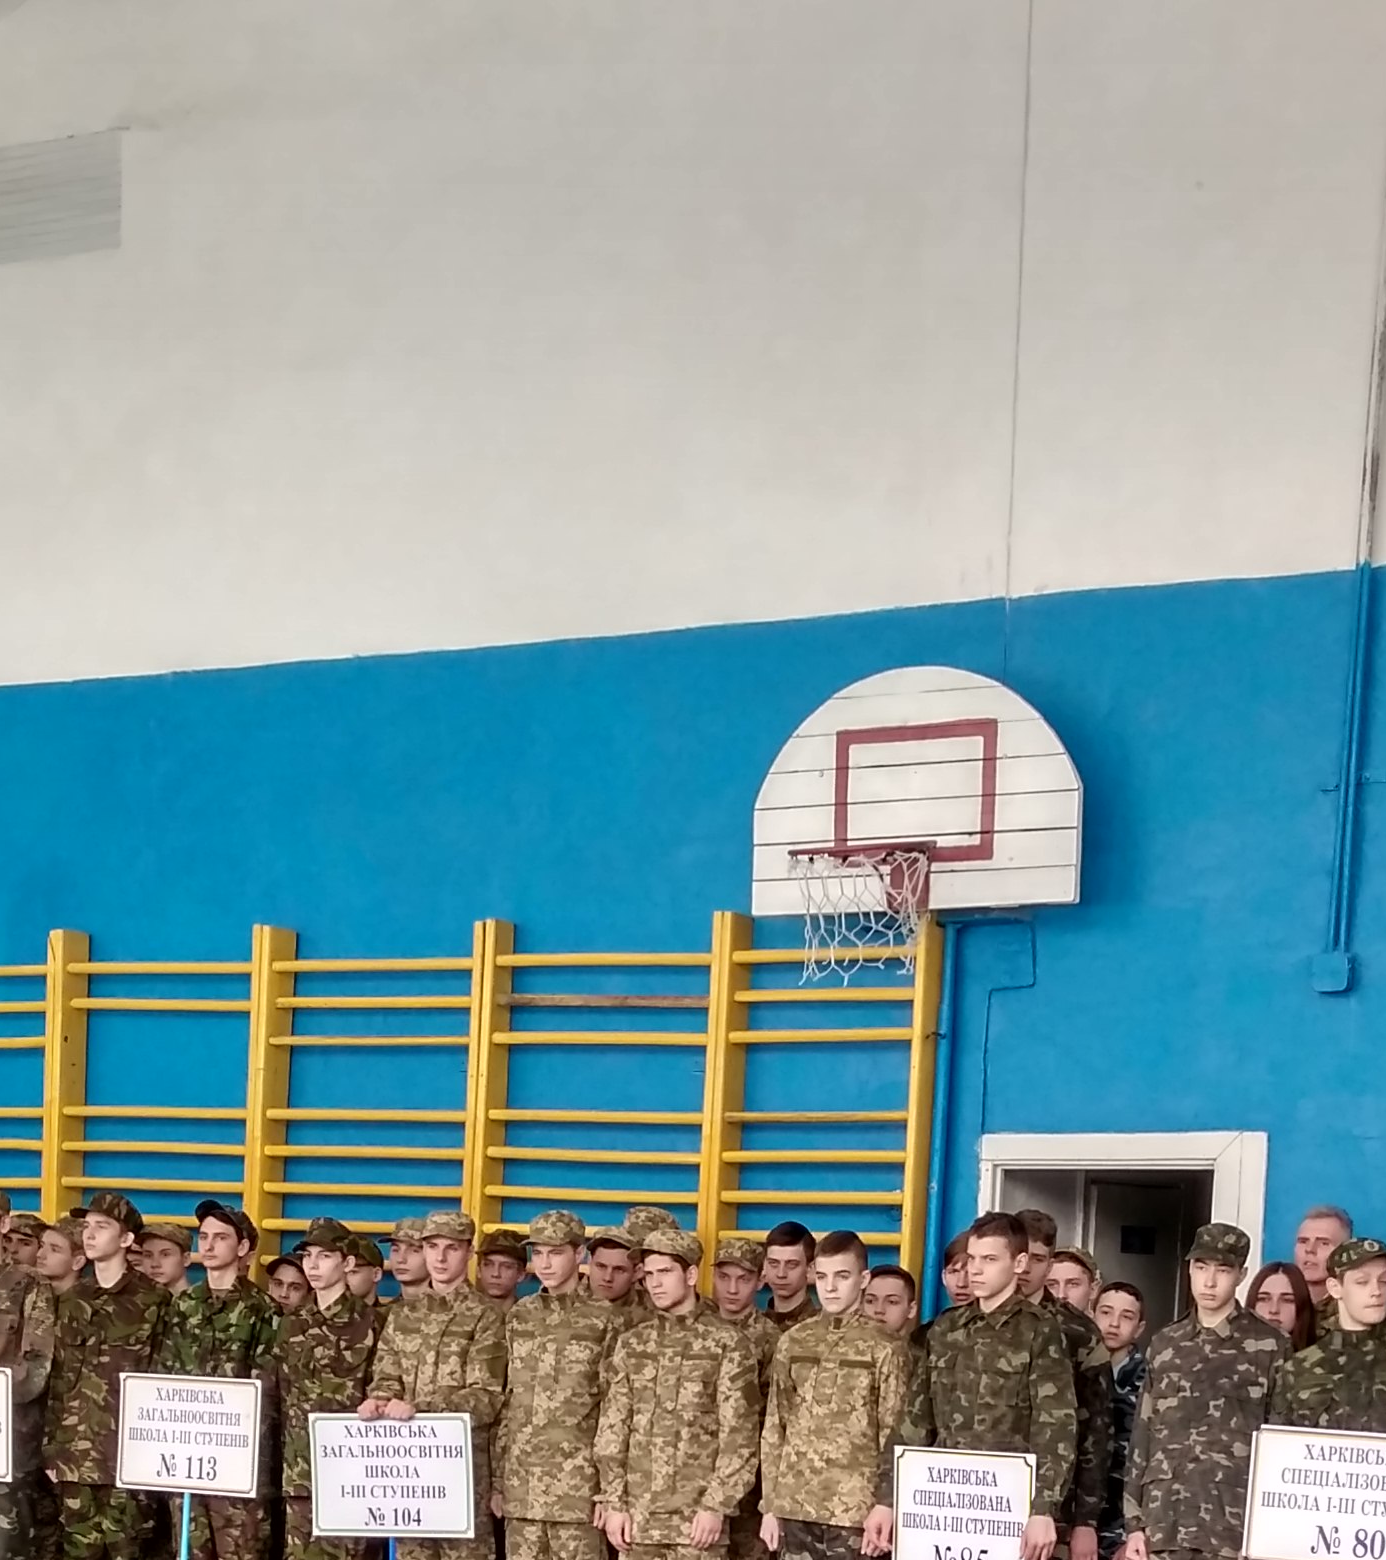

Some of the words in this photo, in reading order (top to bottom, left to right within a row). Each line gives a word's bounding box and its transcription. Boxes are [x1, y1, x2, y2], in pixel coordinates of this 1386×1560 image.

[156, 1387, 225, 1404] ХАРКІВСЬКА
[138, 1407, 241, 1426] ЗАГАЛЬНООСВІТНЯ
[128, 1427, 168, 1443] ШКОЛА
[194, 1431, 249, 1448] СТУПЕНІВ
[344, 1425, 438, 1438] ХАРКІВСЬКА
[320, 1445, 463, 1458] ЗАГАЛЬНООСВІТНЯ
[156, 1453, 177, 1477] №
[185, 1455, 218, 1481] 113
[365, 1465, 420, 1478] ШКОЛА
[927, 1467, 998, 1487] ХАРКІВСЬКА
[370, 1485, 447, 1499] СТУПЕНІВ
[913, 1489, 1012, 1513] СПЕЦІАЛІЗОВАНА
[1261, 1491, 1321, 1511] ШКОЛА
[364, 1507, 386, 1526] №
[392, 1507, 422, 1526] 104
[902, 1512, 941, 1531] ШКОЛА
[965, 1517, 1024, 1538] СТУПЕНІВ
[1310, 1525, 1341, 1555] №
[1352, 1528, 1386, 1560] 80
